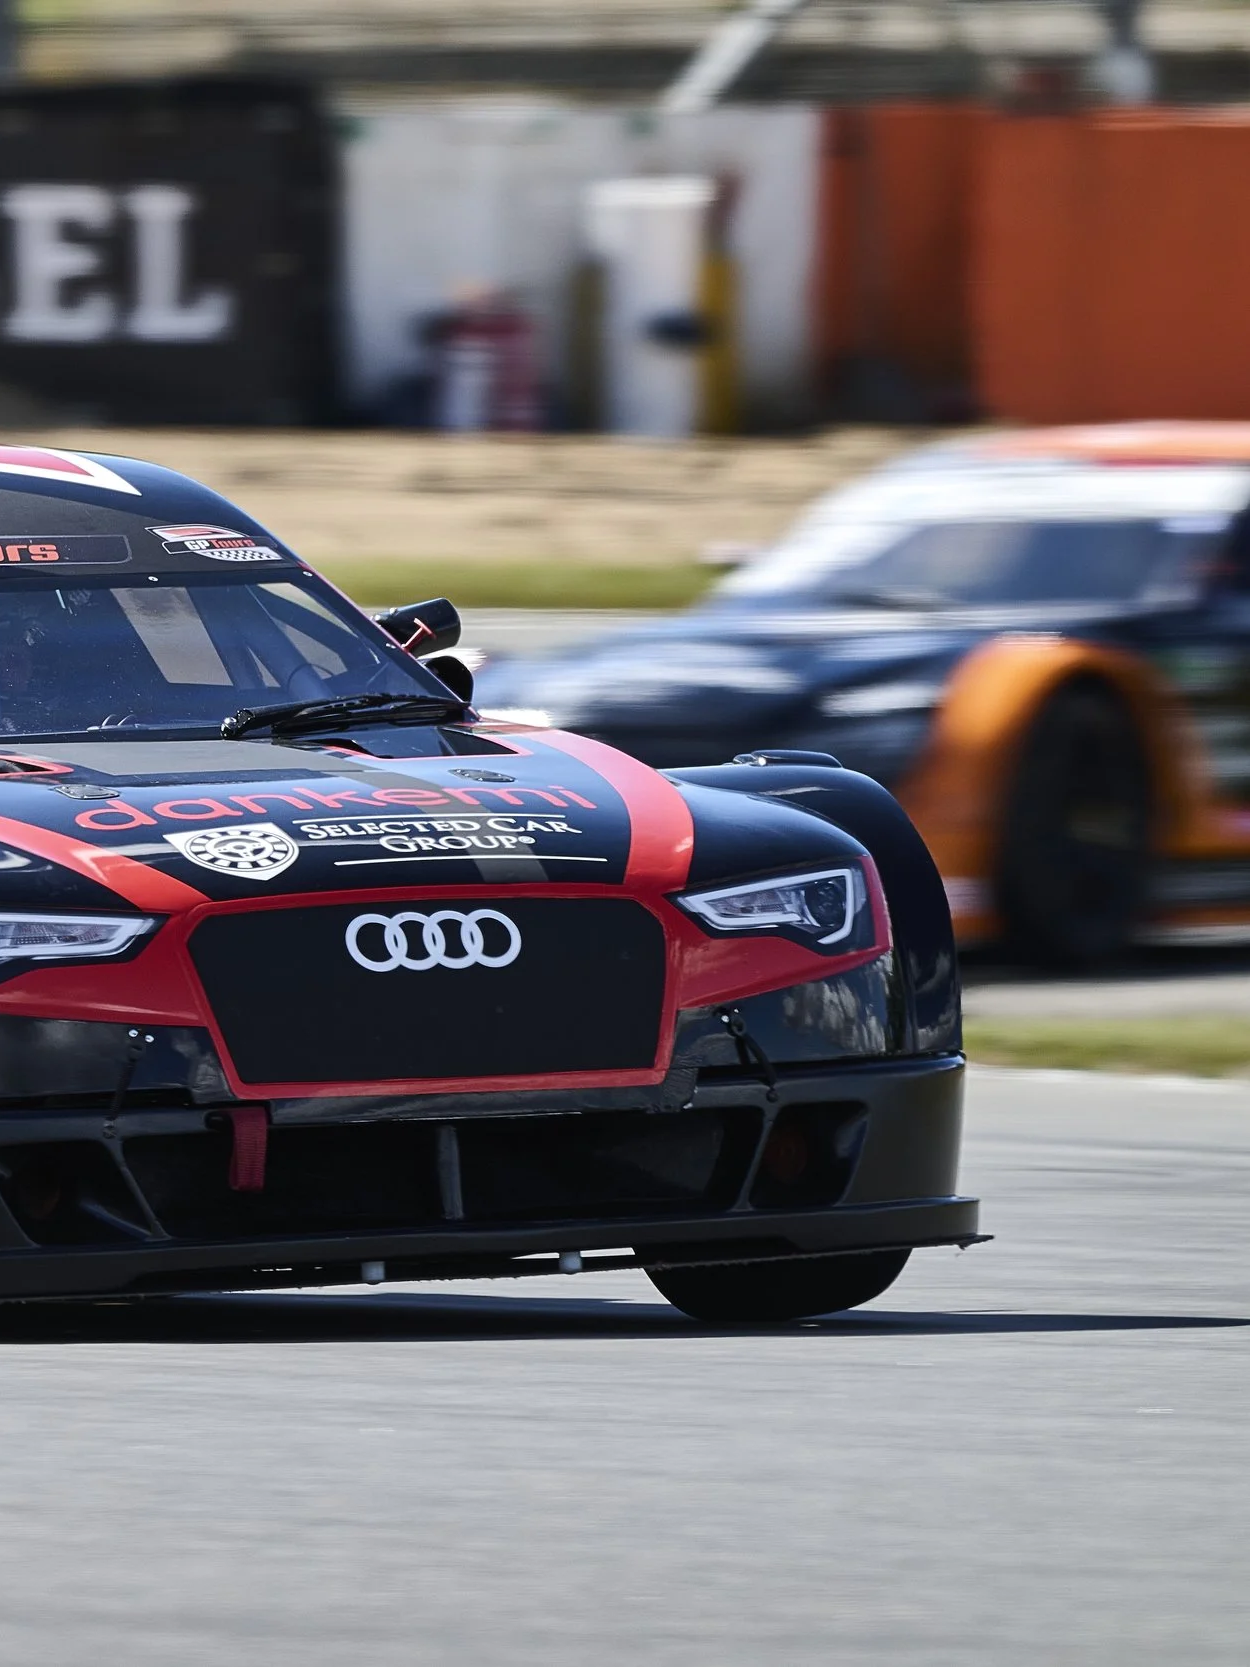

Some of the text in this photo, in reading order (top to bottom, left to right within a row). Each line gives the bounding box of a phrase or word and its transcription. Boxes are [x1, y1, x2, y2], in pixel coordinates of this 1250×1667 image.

[184, 538, 256, 550] GP Tours
[74, 784, 598, 831] dankemi
[300, 817, 583, 840] SELECTED CAR
